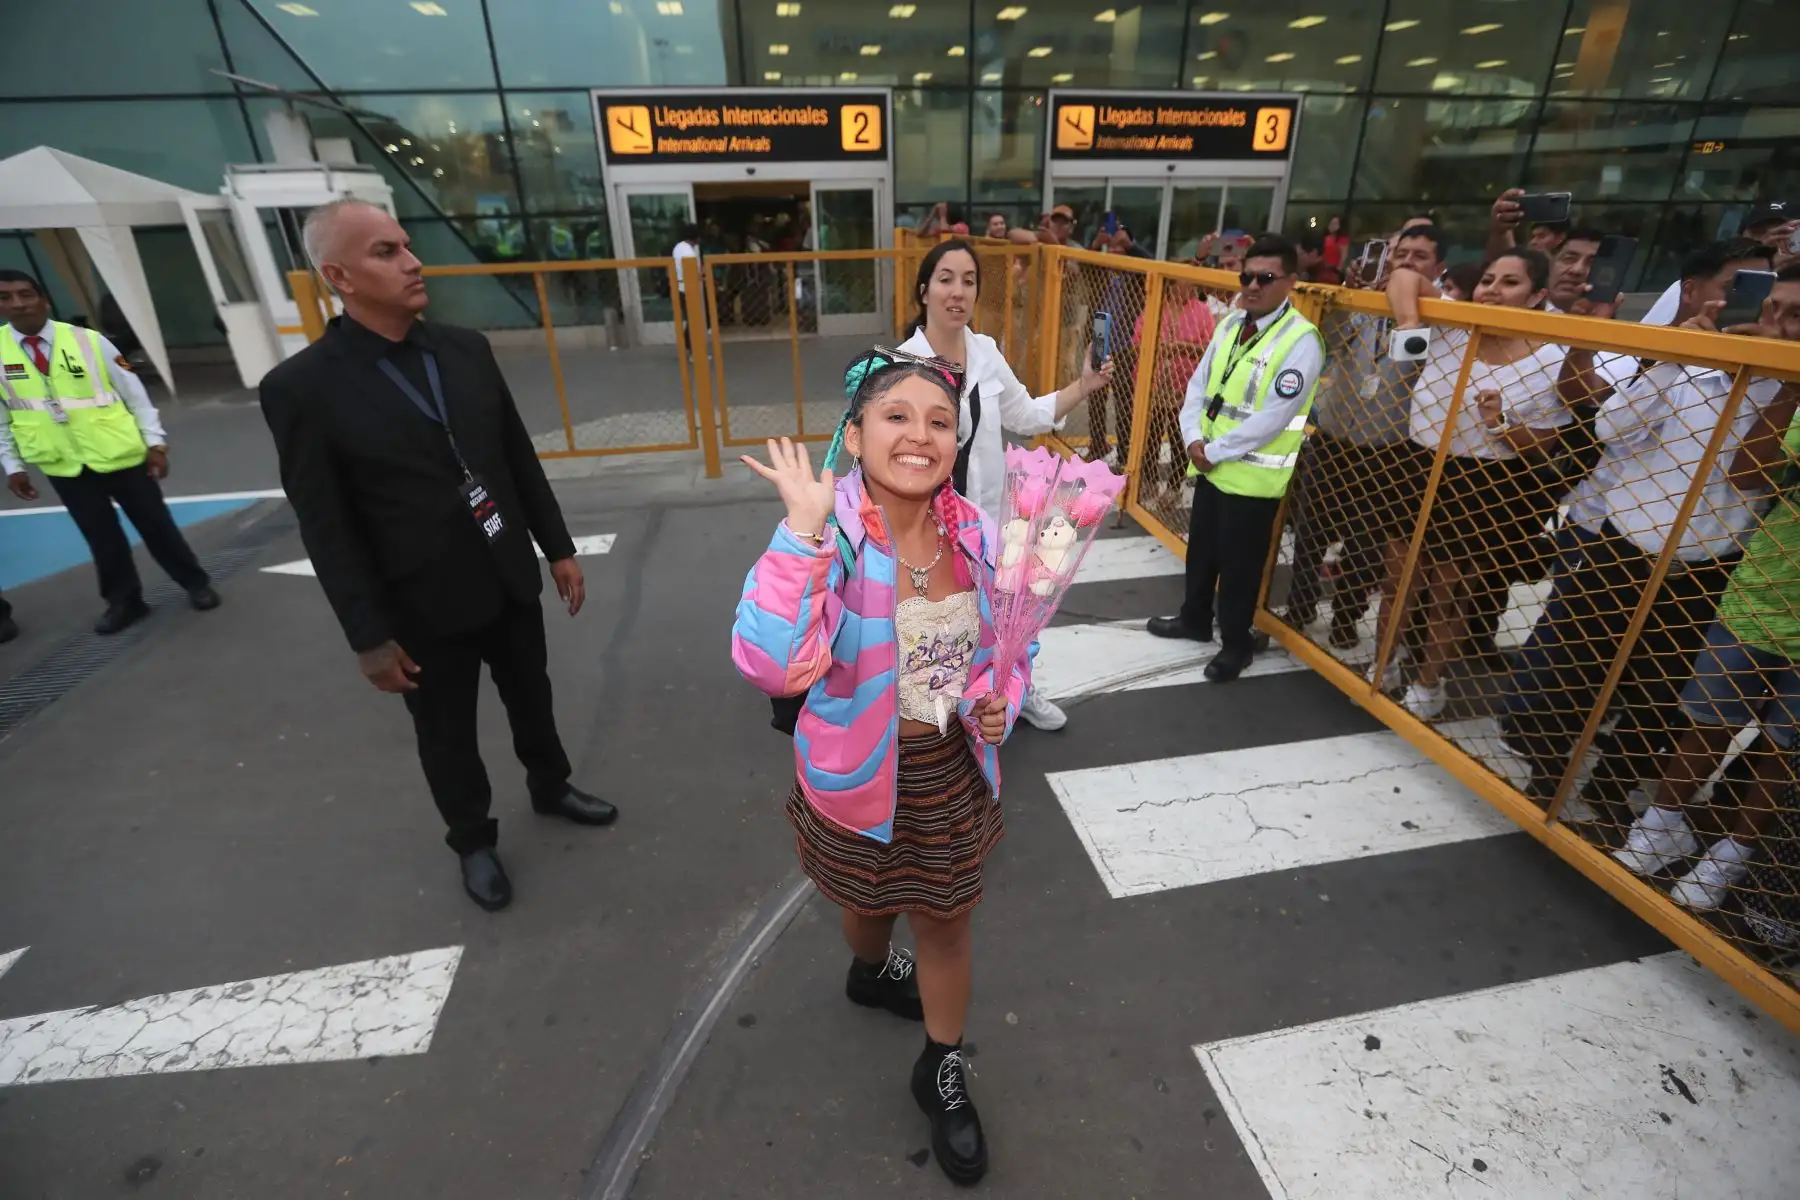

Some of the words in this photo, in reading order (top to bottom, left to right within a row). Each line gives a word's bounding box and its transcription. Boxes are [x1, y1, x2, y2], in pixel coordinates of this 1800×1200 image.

[654, 104, 720, 131] Llegadas
[722, 105, 829, 127] Internacionales
[853, 111, 870, 144] 2
[1098, 105, 1154, 129] Llegadas
[1156, 106, 1247, 127] Internacionales
[1263, 114, 1280, 145] 3
[657, 137, 728, 153] International
[728, 135, 772, 152] Arrivals
[1097, 135, 1157, 151] International
[1158, 135, 1193, 151] Arrivals
[483, 512, 503, 537] STAFF
